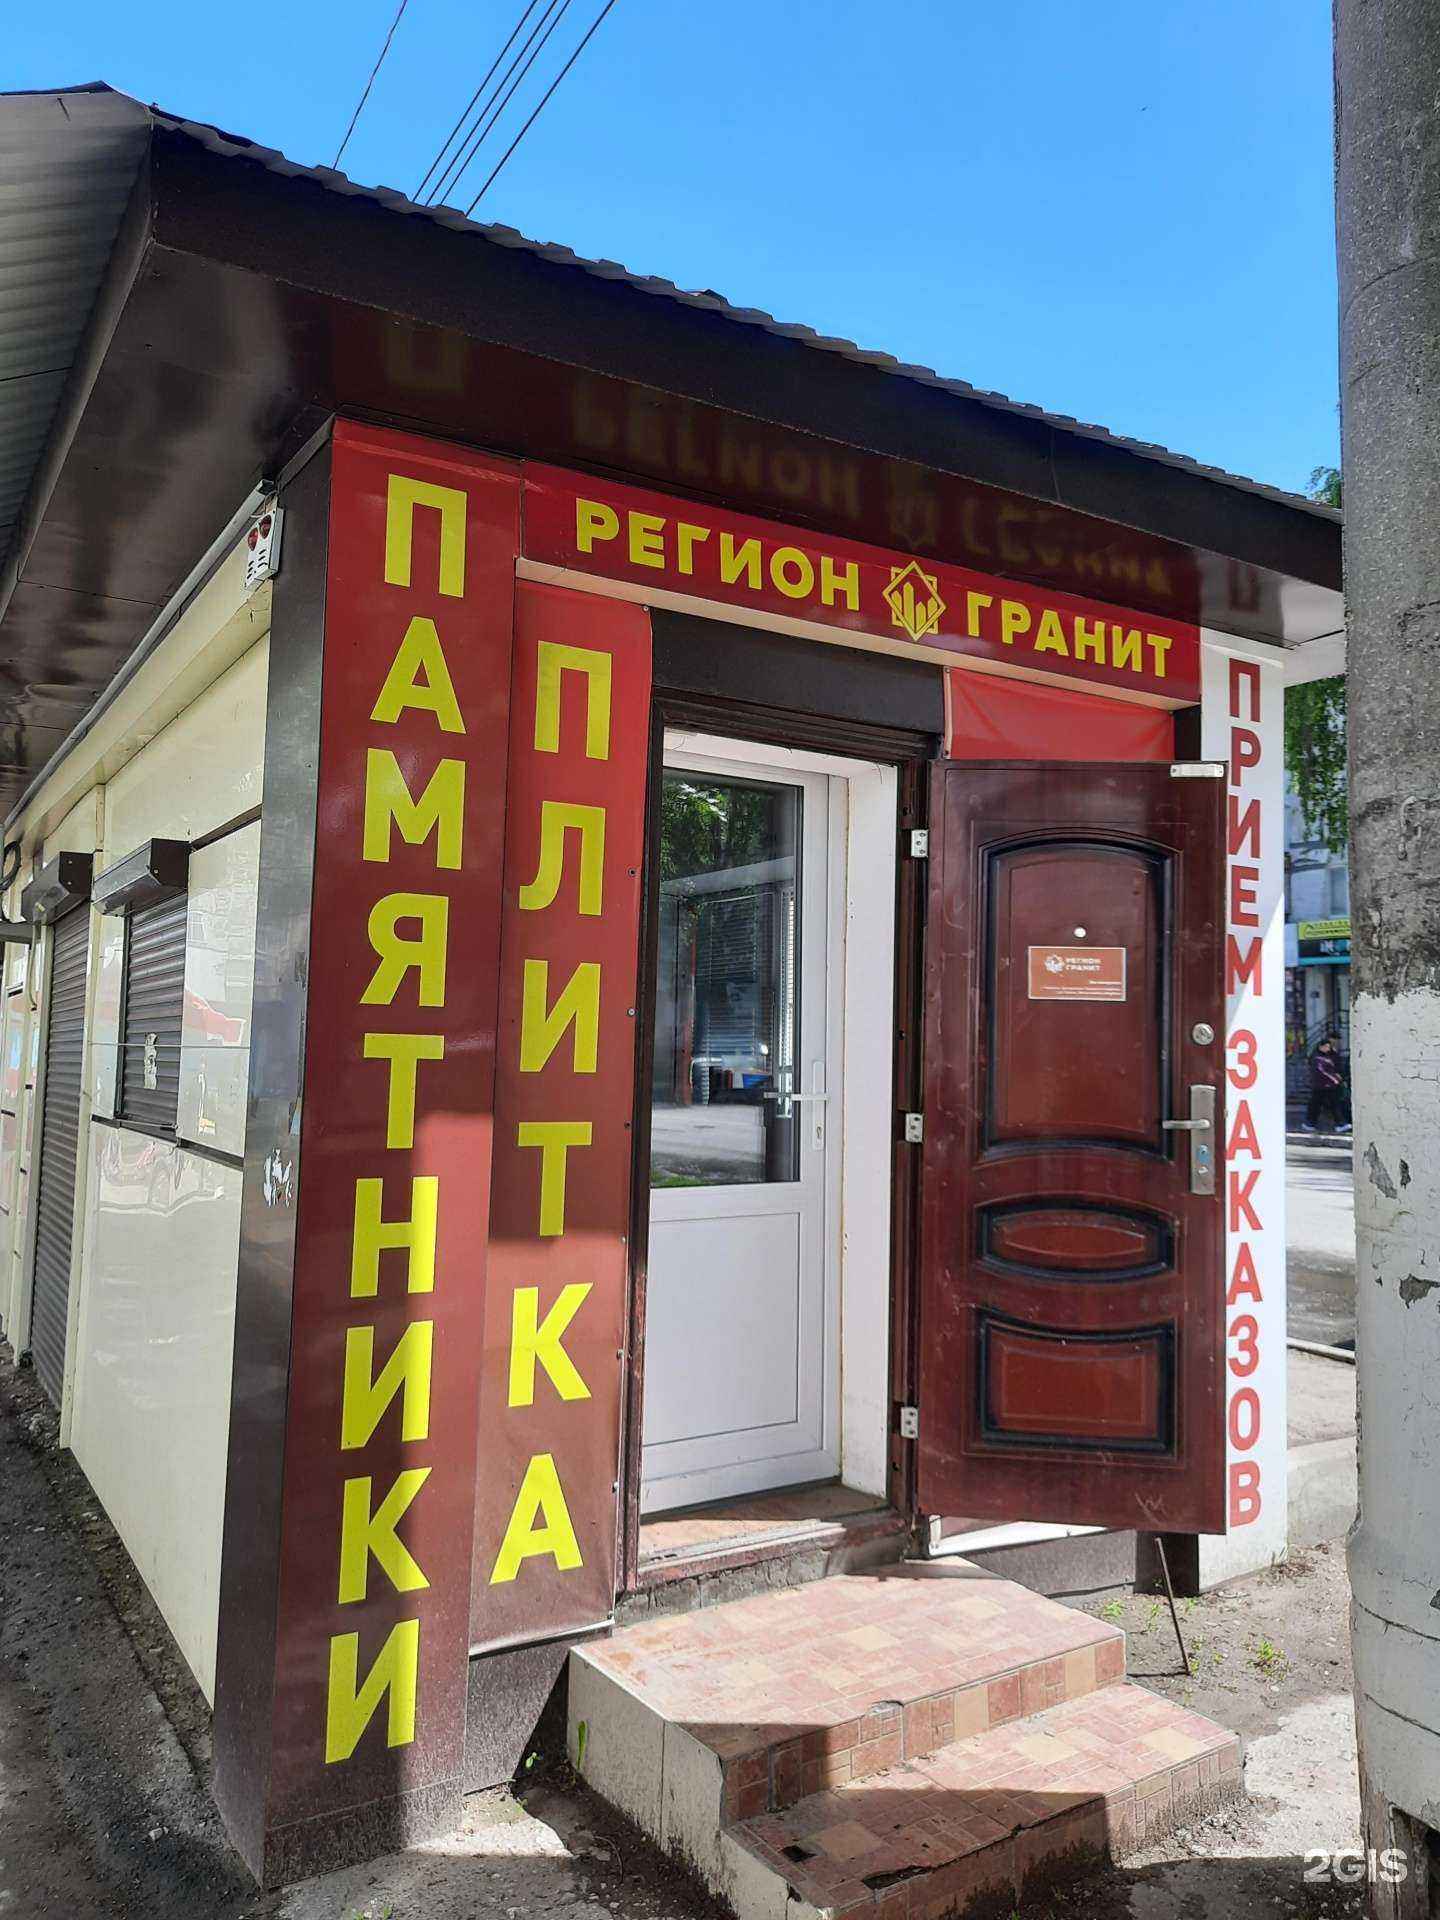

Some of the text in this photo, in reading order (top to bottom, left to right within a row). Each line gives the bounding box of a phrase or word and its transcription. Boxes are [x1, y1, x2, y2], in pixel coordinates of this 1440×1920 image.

[575, 497, 860, 612] РЕГИОН
[966, 591, 1174, 678] ГРАНИТ
[324, 474, 469, 1765] ПАМЯТНИКИ
[490, 641, 613, 1586] ПЛИТКА
[1225, 657, 1264, 1528] ПРИЕМ ЗАКАЗОВ
